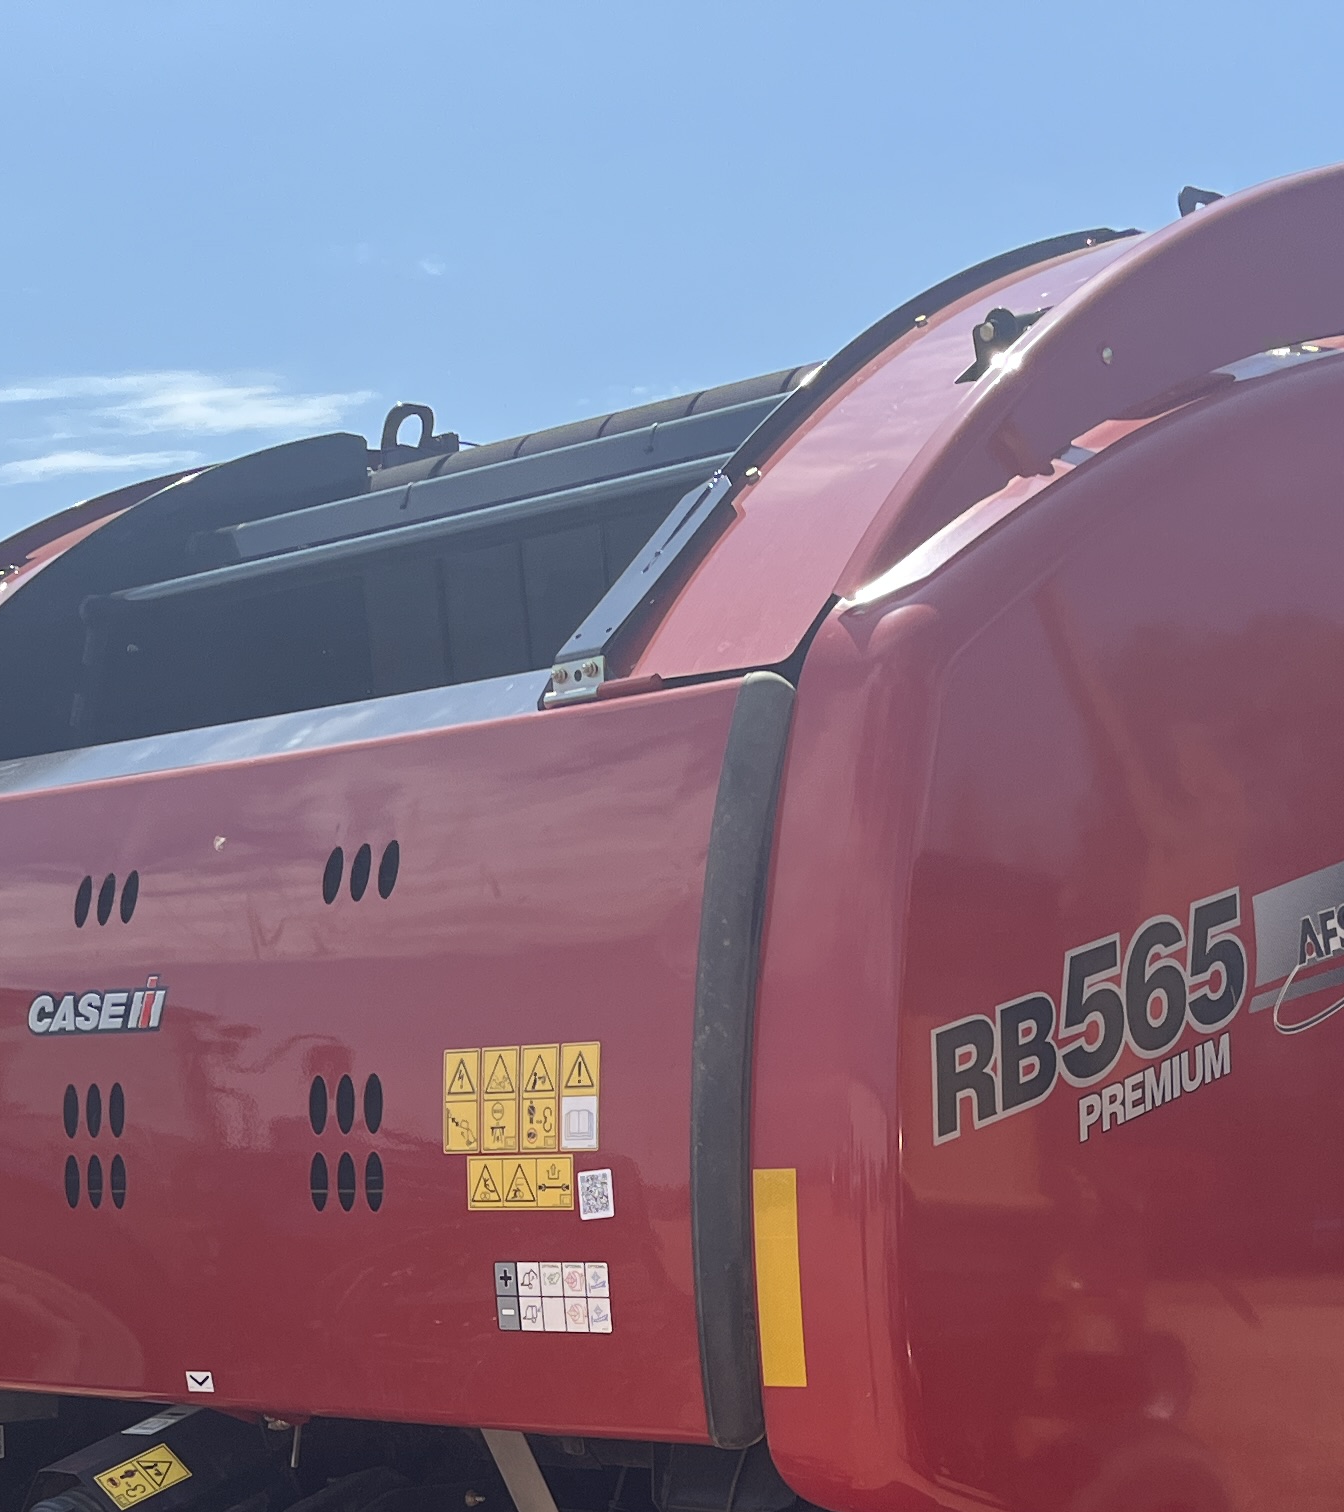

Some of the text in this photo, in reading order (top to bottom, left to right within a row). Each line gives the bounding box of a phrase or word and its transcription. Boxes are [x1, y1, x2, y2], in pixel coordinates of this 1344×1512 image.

[28, 991, 129, 1034] CASE
[930, 885, 1248, 1147] RB565
[1078, 1032, 1232, 1143] PREMIUM
